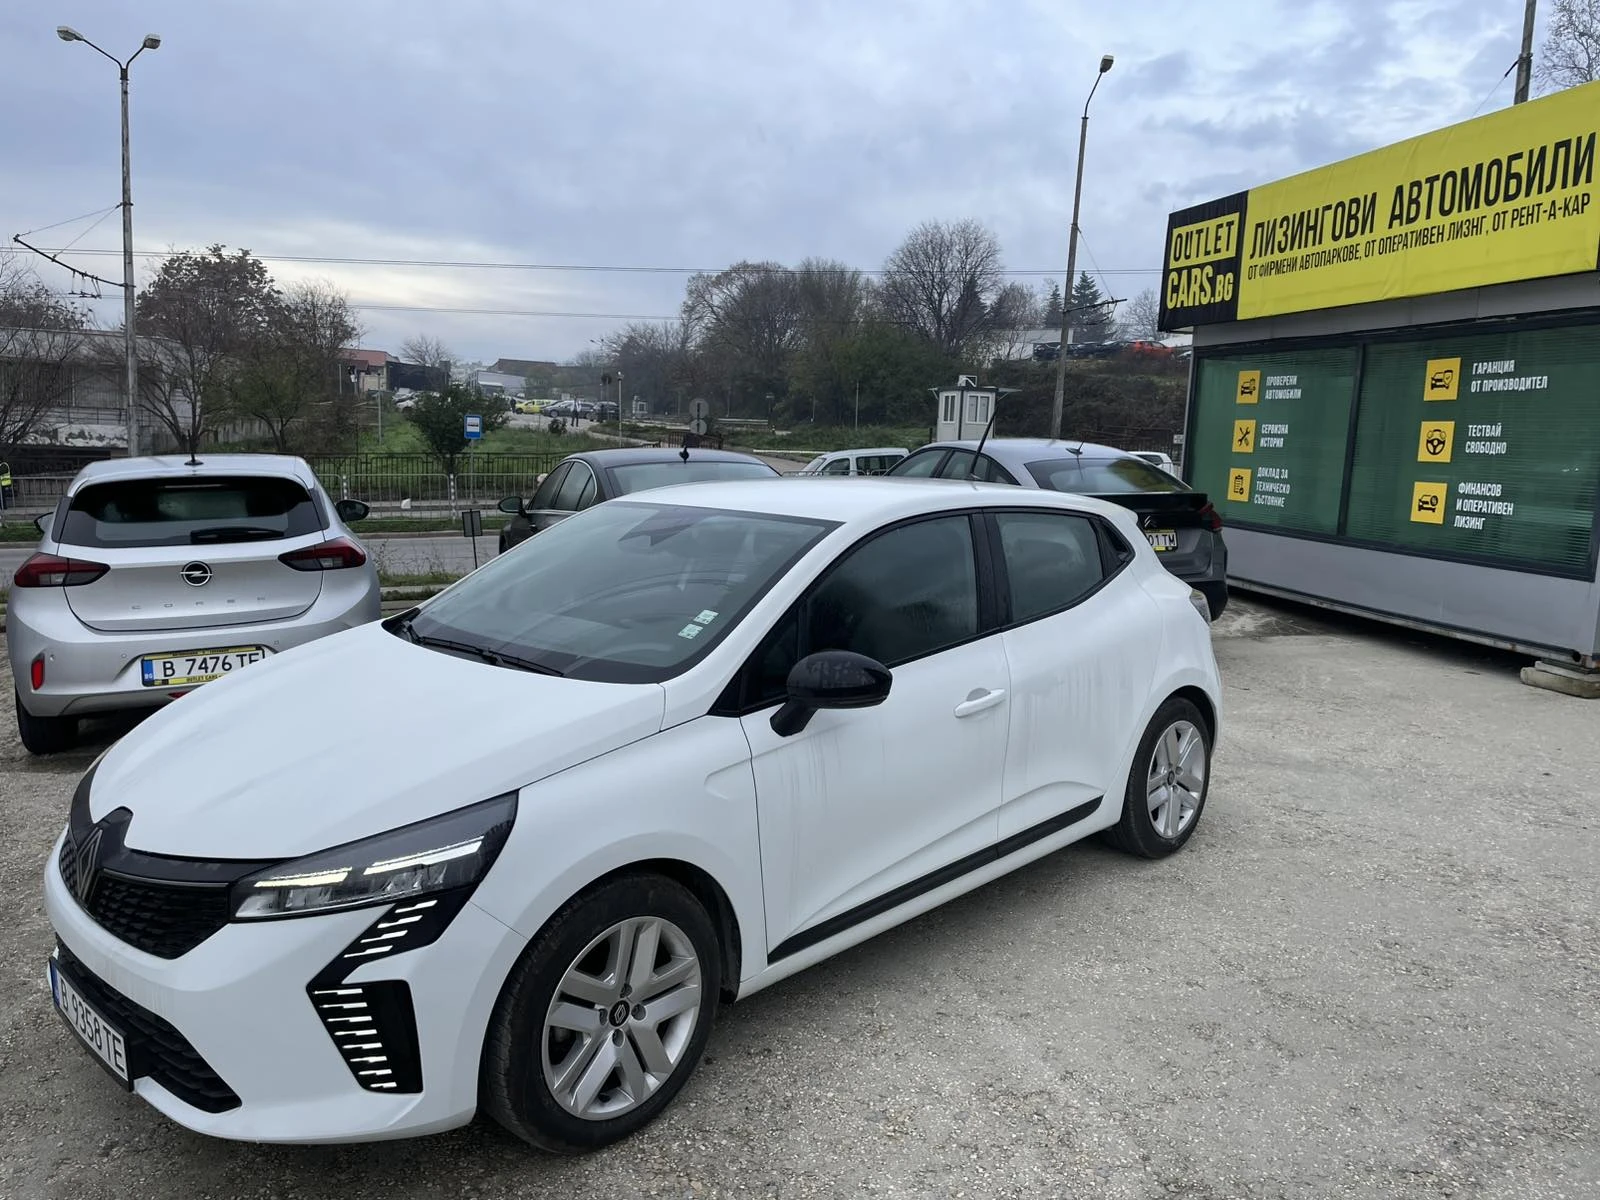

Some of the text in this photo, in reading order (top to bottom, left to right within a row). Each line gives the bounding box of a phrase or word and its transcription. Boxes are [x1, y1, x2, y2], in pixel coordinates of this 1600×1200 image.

[1249, 131, 1596, 260] ЛИЗИНГОВИ АВТОМОБИЛИ
[1173, 219, 1235, 262] OUTLET
[1247, 264, 1259, 280] ОТ
[1259, 256, 1297, 277] ФИРМЕНИ
[1299, 242, 1362, 271] АВТОПАРКОВЕ,
[1364, 239, 1377, 258] ОТ
[1378, 223, 1445, 256] ОПЕРАТИВЕН
[1492, 210, 1509, 232] ОТ
[1510, 192, 1591, 229] РЕНТ-А-КАР
[1166, 264, 1234, 309] CARS.BG
[1472, 359, 1515, 375] ГАРАНЦИЯ
[1265, 375, 1298, 387] ПРОВЕРЕНИ
[1470, 375, 1549, 393] ОТ ПРОИЗВОДИТЕЛ
[1264, 388, 1302, 400] АВТОМОБИЛИ
[1468, 422, 1503, 437] ТЕСТВАЙ
[1259, 437, 1284, 448] ИСТОРИЯ
[1465, 441, 1507, 456] СВОБОДНО
[1257, 466, 1289, 479] ДОКЛАД ЗА
[1256, 481, 1291, 494] ТЕХНИЧЕСКО
[1458, 482, 1502, 497] ФИНАНСОВ
[1254, 494, 1286, 508] СЪСТОЯНИЕ
[1456, 498, 1514, 515] И ОПЕРАТИВЕН
[1453, 515, 1486, 530] ЛИЗИНГ
[162, 660, 175, 677] B
[185, 654, 233, 676] 7476
[60, 975, 125, 1073] B 9358 TE
